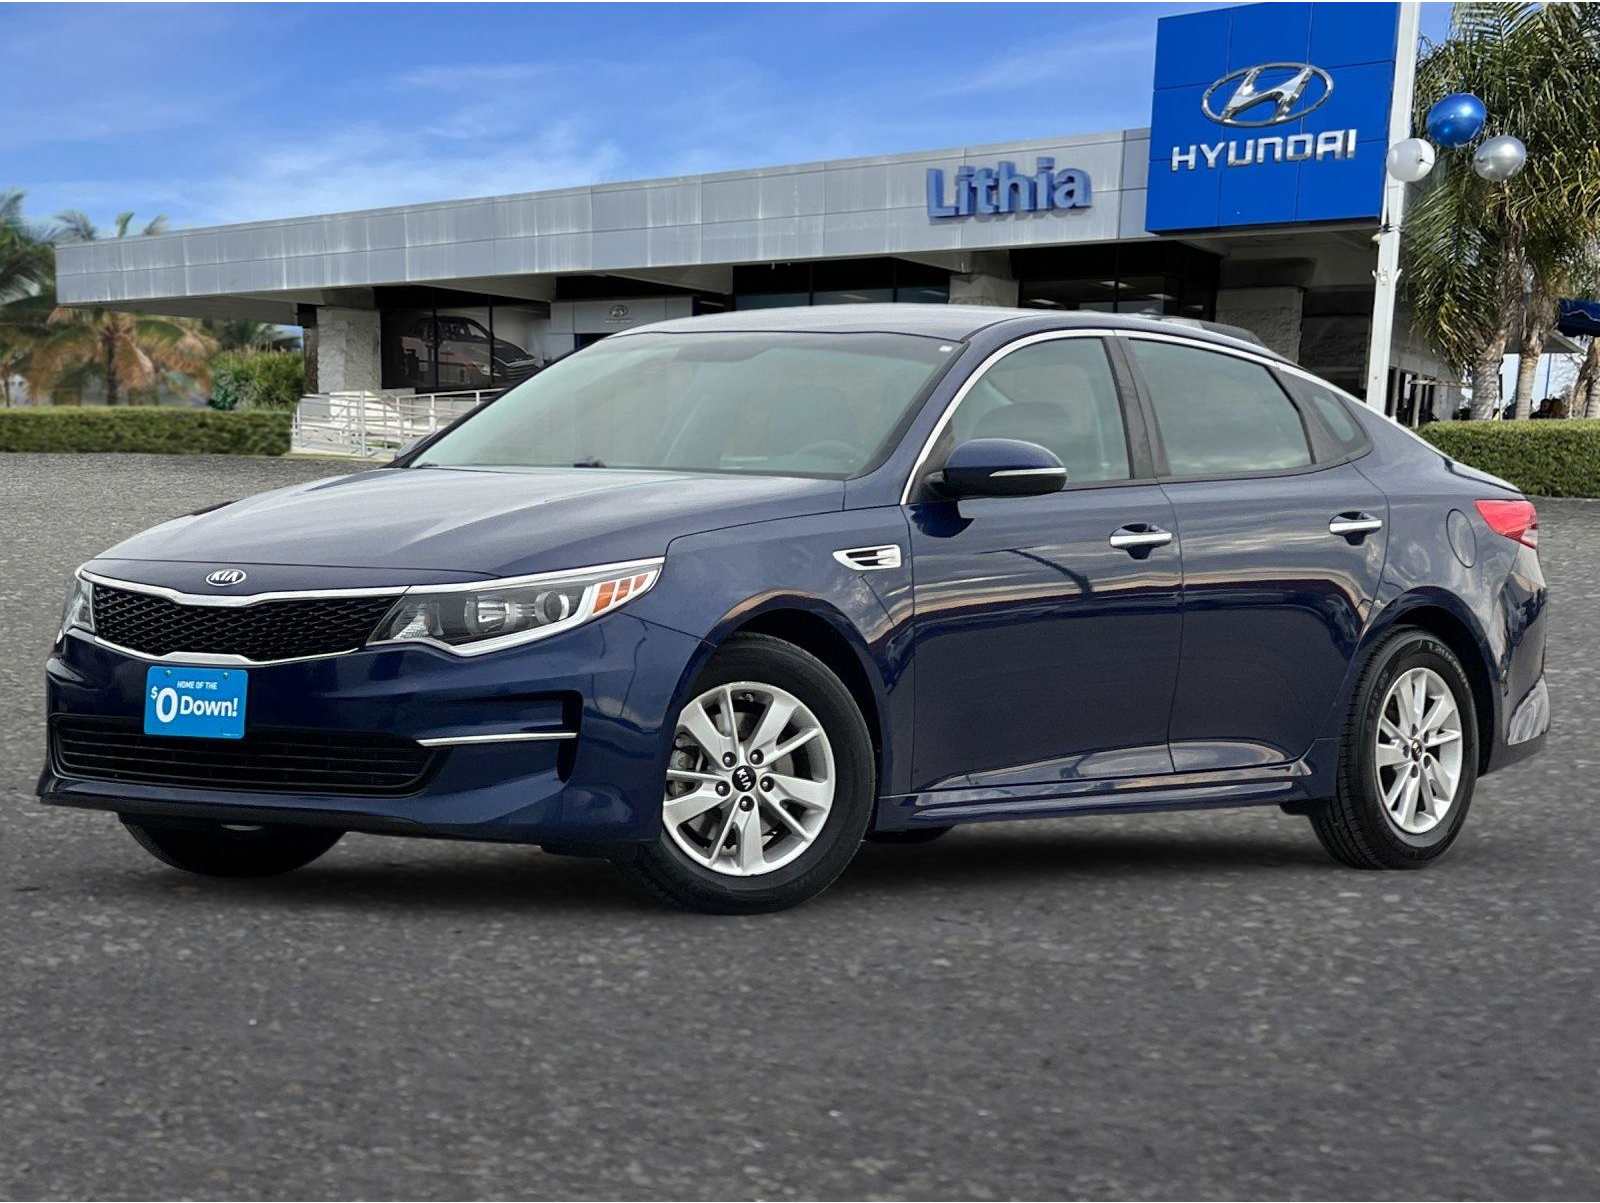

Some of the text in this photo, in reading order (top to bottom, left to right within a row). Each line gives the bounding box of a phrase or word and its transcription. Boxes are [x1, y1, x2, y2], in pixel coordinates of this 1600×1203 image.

[1171, 128, 1358, 171] HYUNDAI
[926, 156, 1092, 219] Lithia
[210, 570, 239, 582] KIA
[176, 680, 218, 690] HOME OF THE
[179, 695, 239, 717] Down!
[736, 768, 752, 790] KIA
